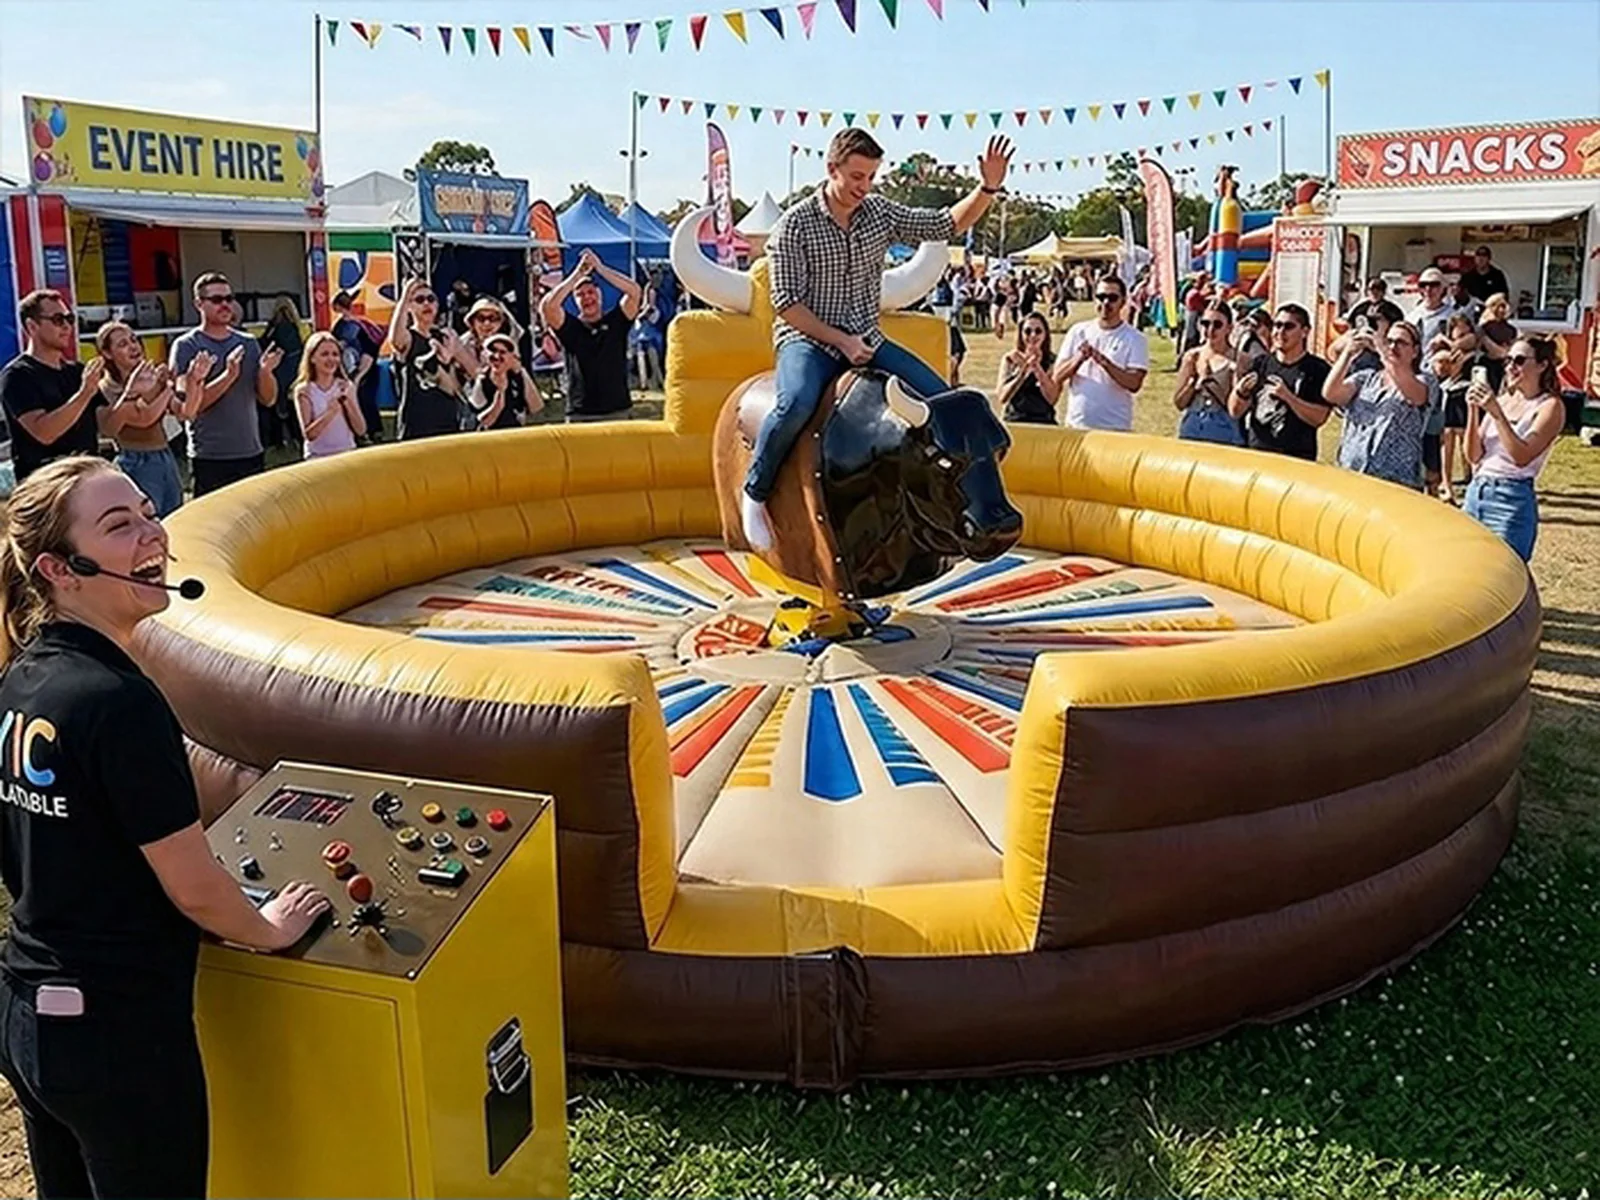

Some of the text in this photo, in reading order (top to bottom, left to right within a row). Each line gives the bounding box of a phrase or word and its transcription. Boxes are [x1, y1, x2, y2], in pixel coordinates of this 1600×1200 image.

[88, 125, 285, 183] EVENT HIRE
[1381, 131, 1568, 177] SNACKS
